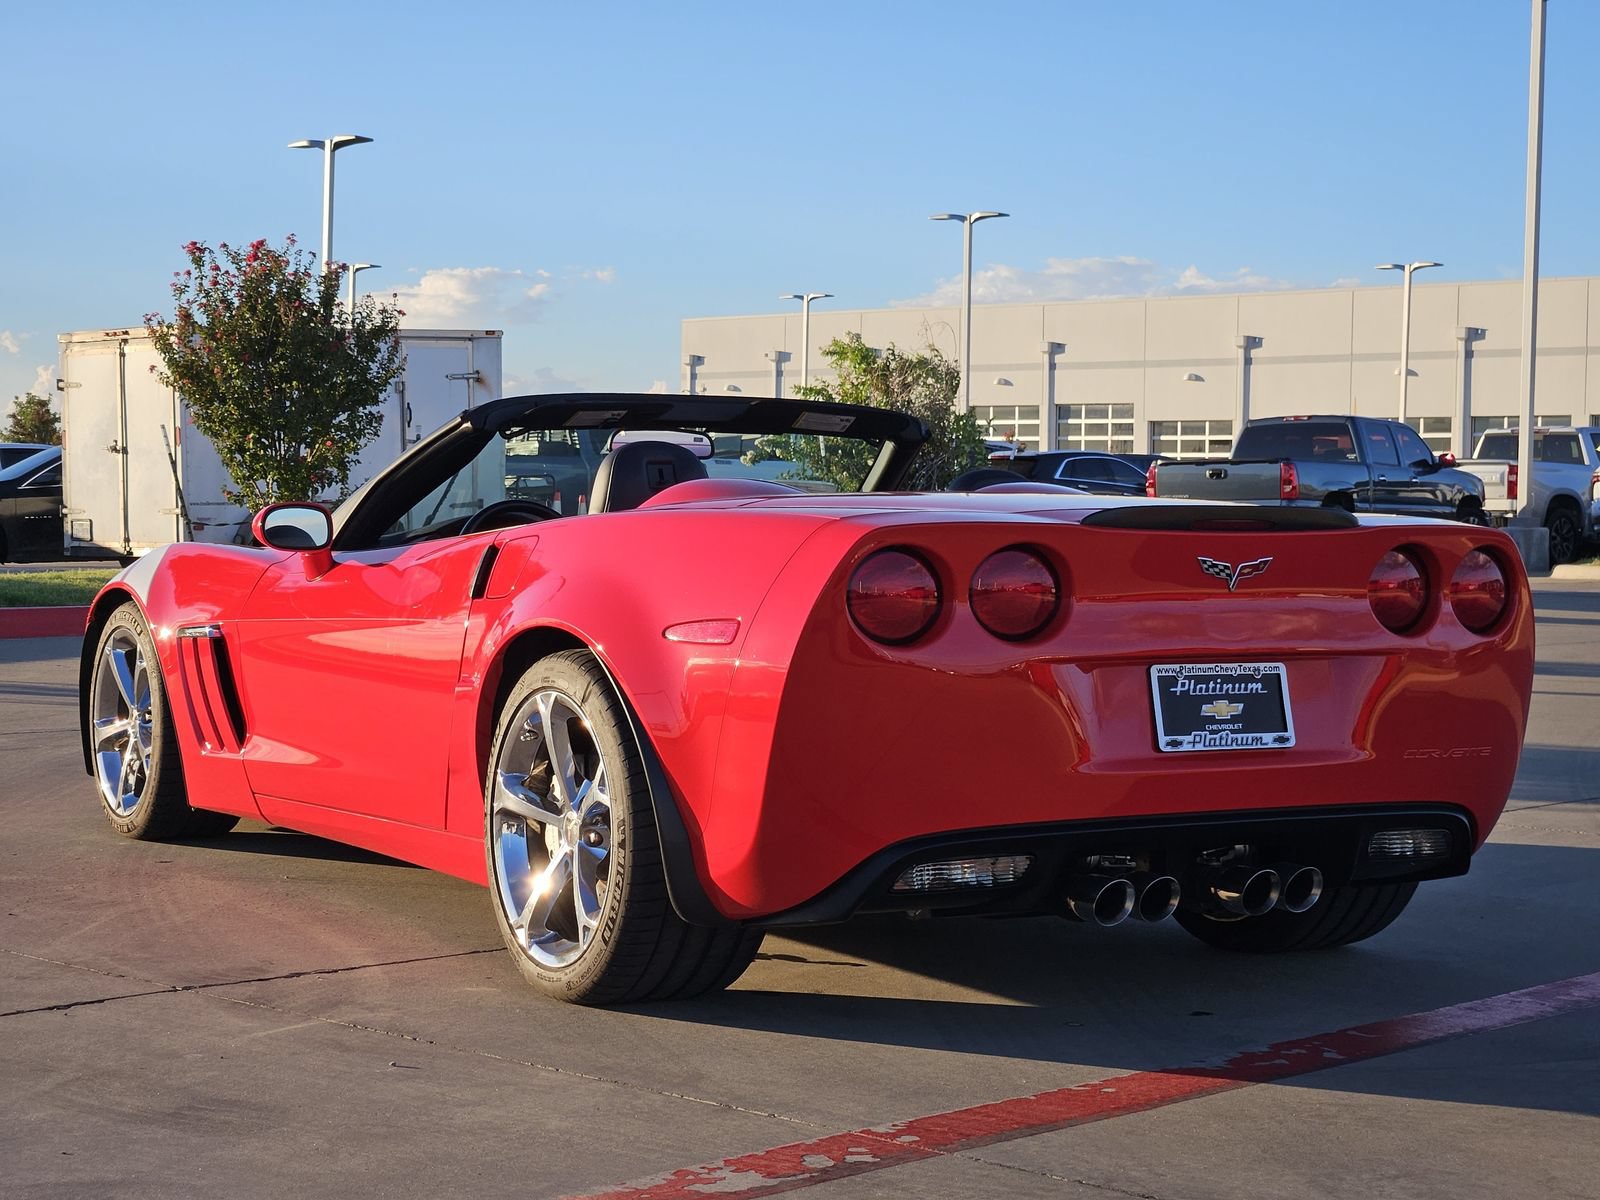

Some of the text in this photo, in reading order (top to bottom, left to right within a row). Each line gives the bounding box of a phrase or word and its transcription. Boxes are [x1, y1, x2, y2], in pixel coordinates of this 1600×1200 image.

[1156, 664, 1280, 676] www.PlatinumChevyTexas.com
[1170, 678, 1268, 696] Platinum
[1205, 723, 1243, 731] CHEVROLET
[1186, 731, 1269, 748] Platinum
[1403, 746, 1492, 759] CORVETTE
[603, 846, 625, 942] MICHELIN
